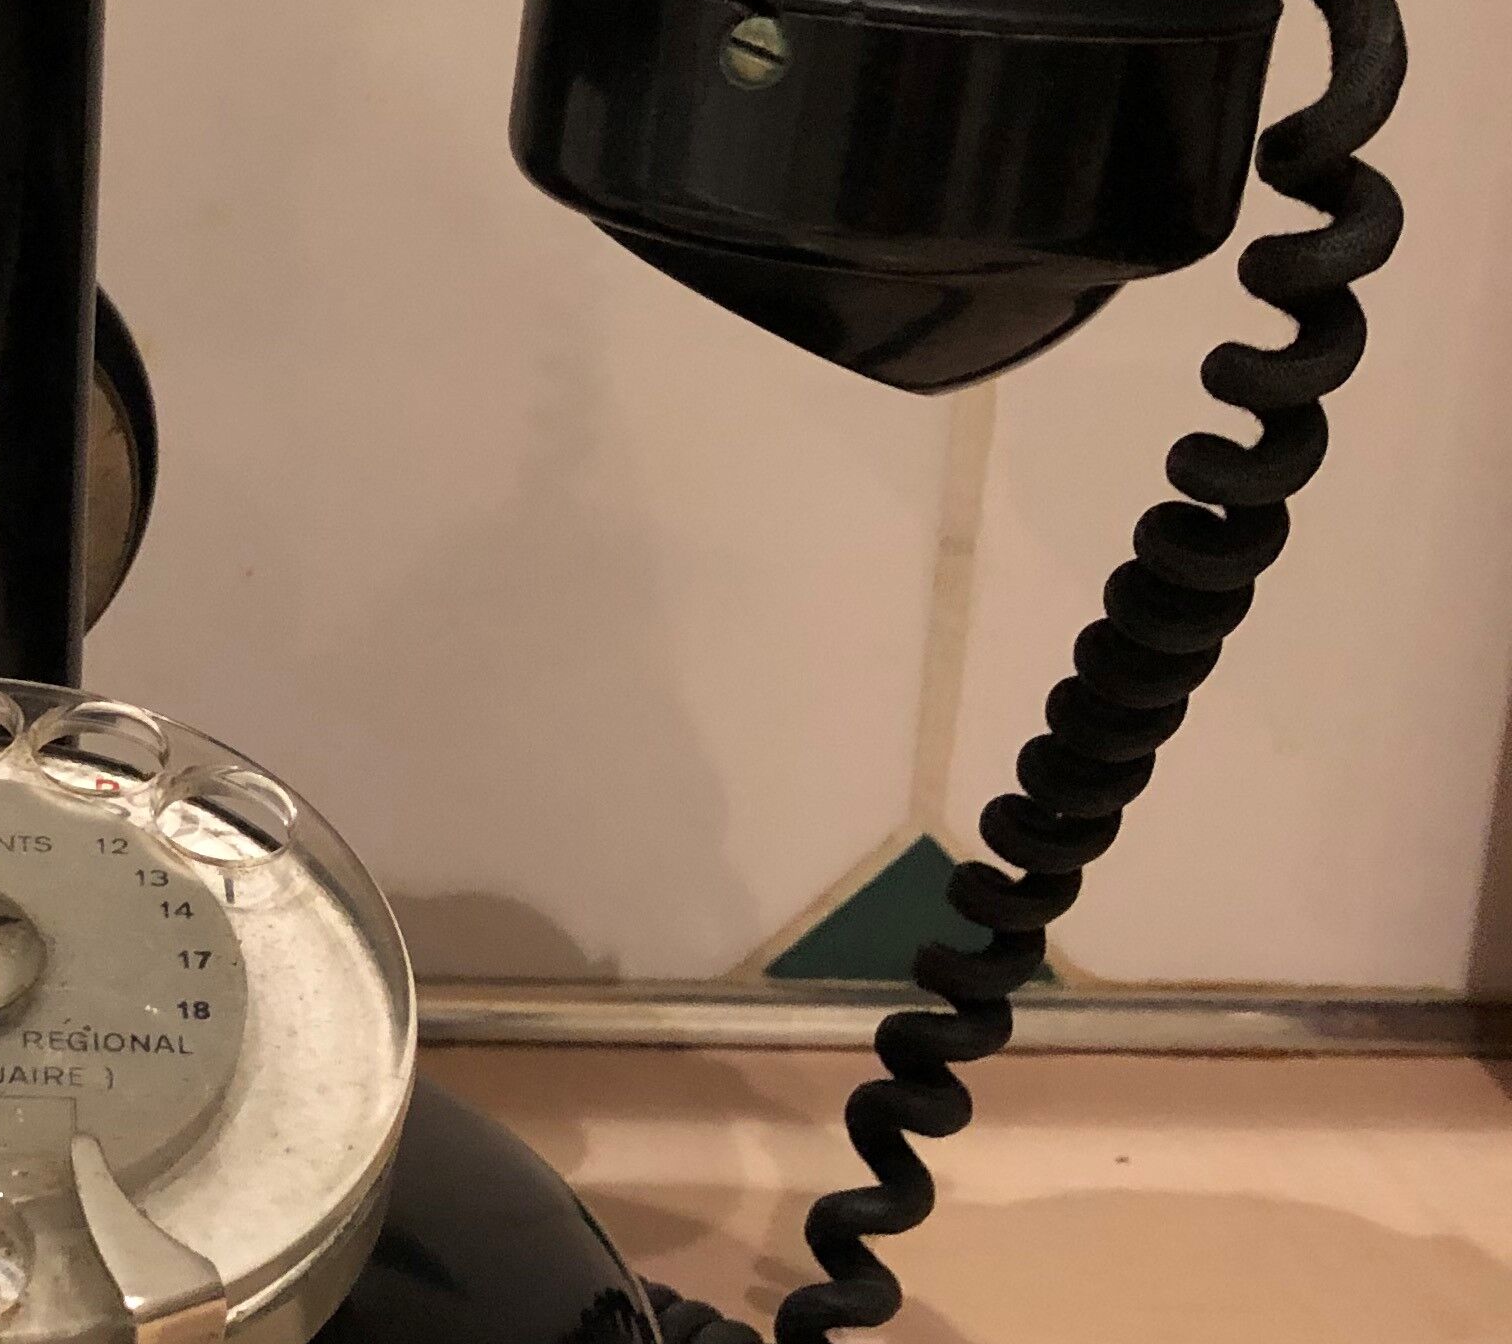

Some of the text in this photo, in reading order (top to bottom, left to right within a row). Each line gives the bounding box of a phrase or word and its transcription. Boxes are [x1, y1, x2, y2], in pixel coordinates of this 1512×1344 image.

[96, 837, 129, 855] 12
[134, 869, 169, 887] 13
[159, 901, 194, 919] 14
[177, 950, 212, 970] 17
[176, 1001, 211, 1019] 18
